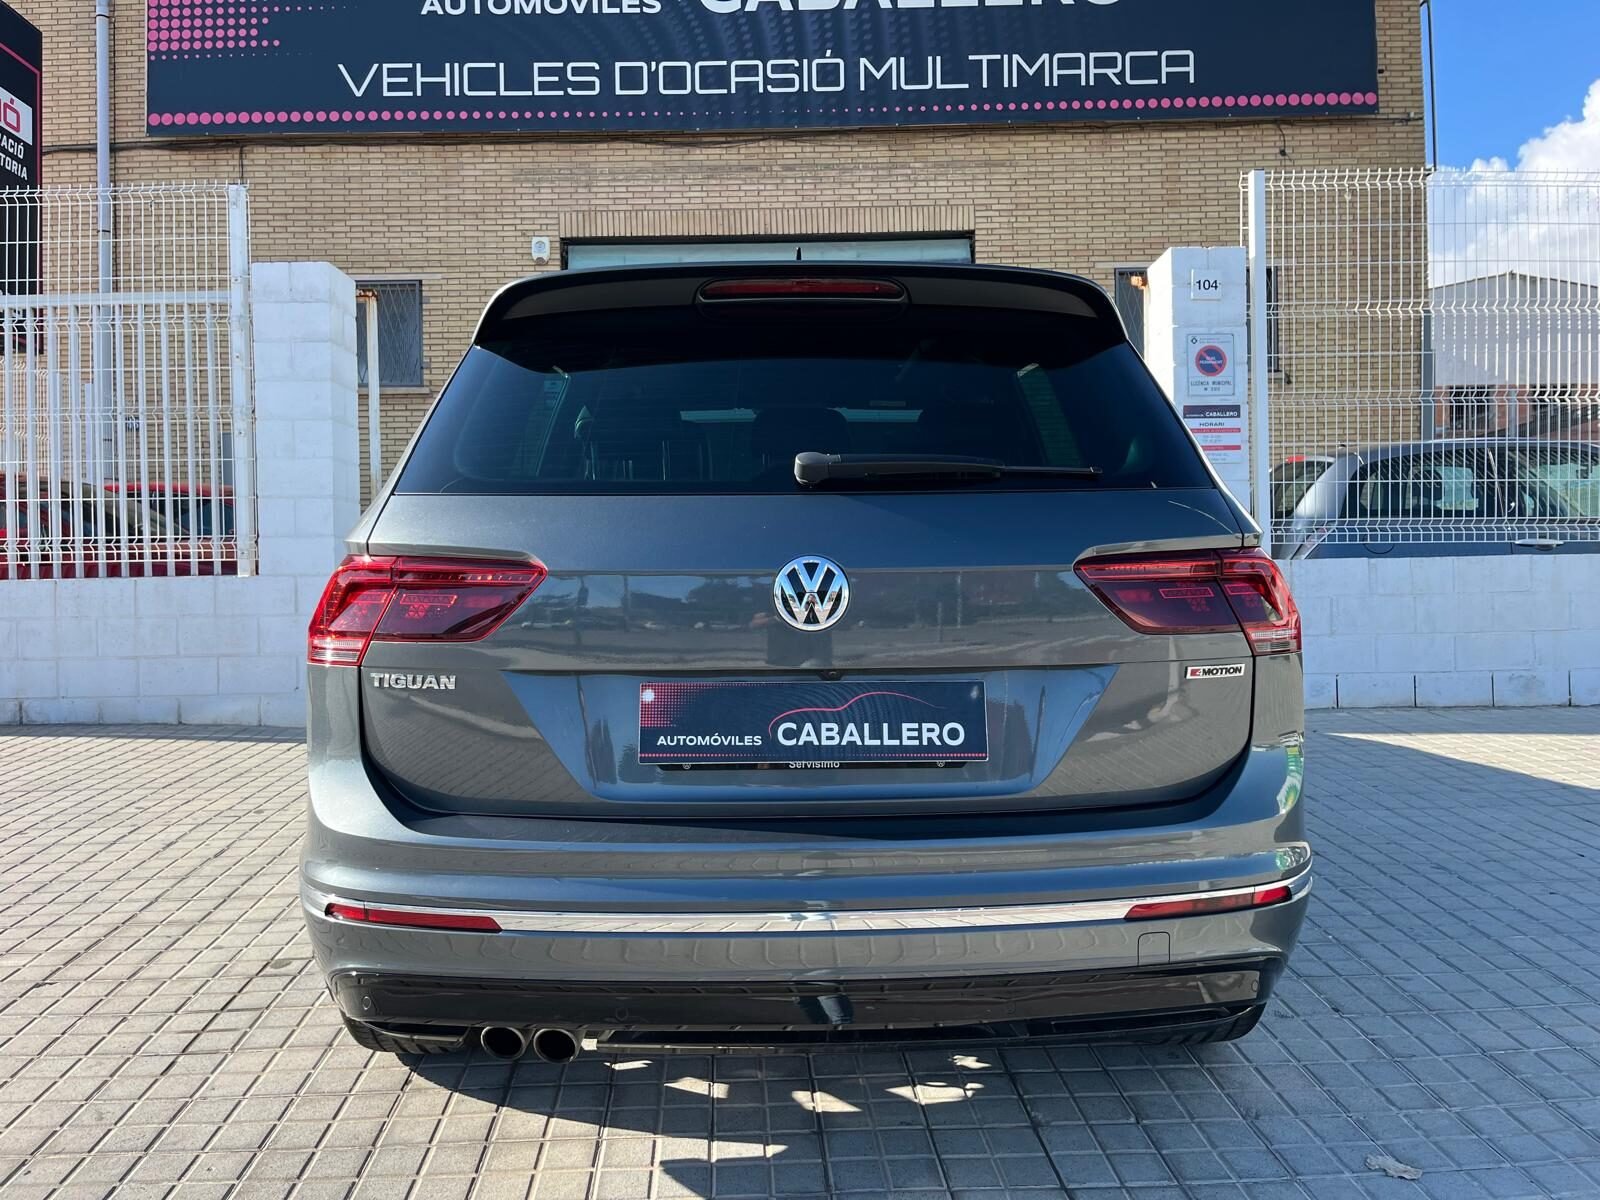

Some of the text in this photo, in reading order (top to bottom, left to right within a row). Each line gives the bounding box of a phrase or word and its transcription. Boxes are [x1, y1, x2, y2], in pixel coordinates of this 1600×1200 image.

[337, 50, 1195, 97] VEHICLES D'OCASIÓ MULTIMARCA
[1196, 279, 1218, 291] 104
[370, 672, 457, 690] TIGUAN
[656, 722, 965, 746] AUTOMÓVILES CABALLERO
